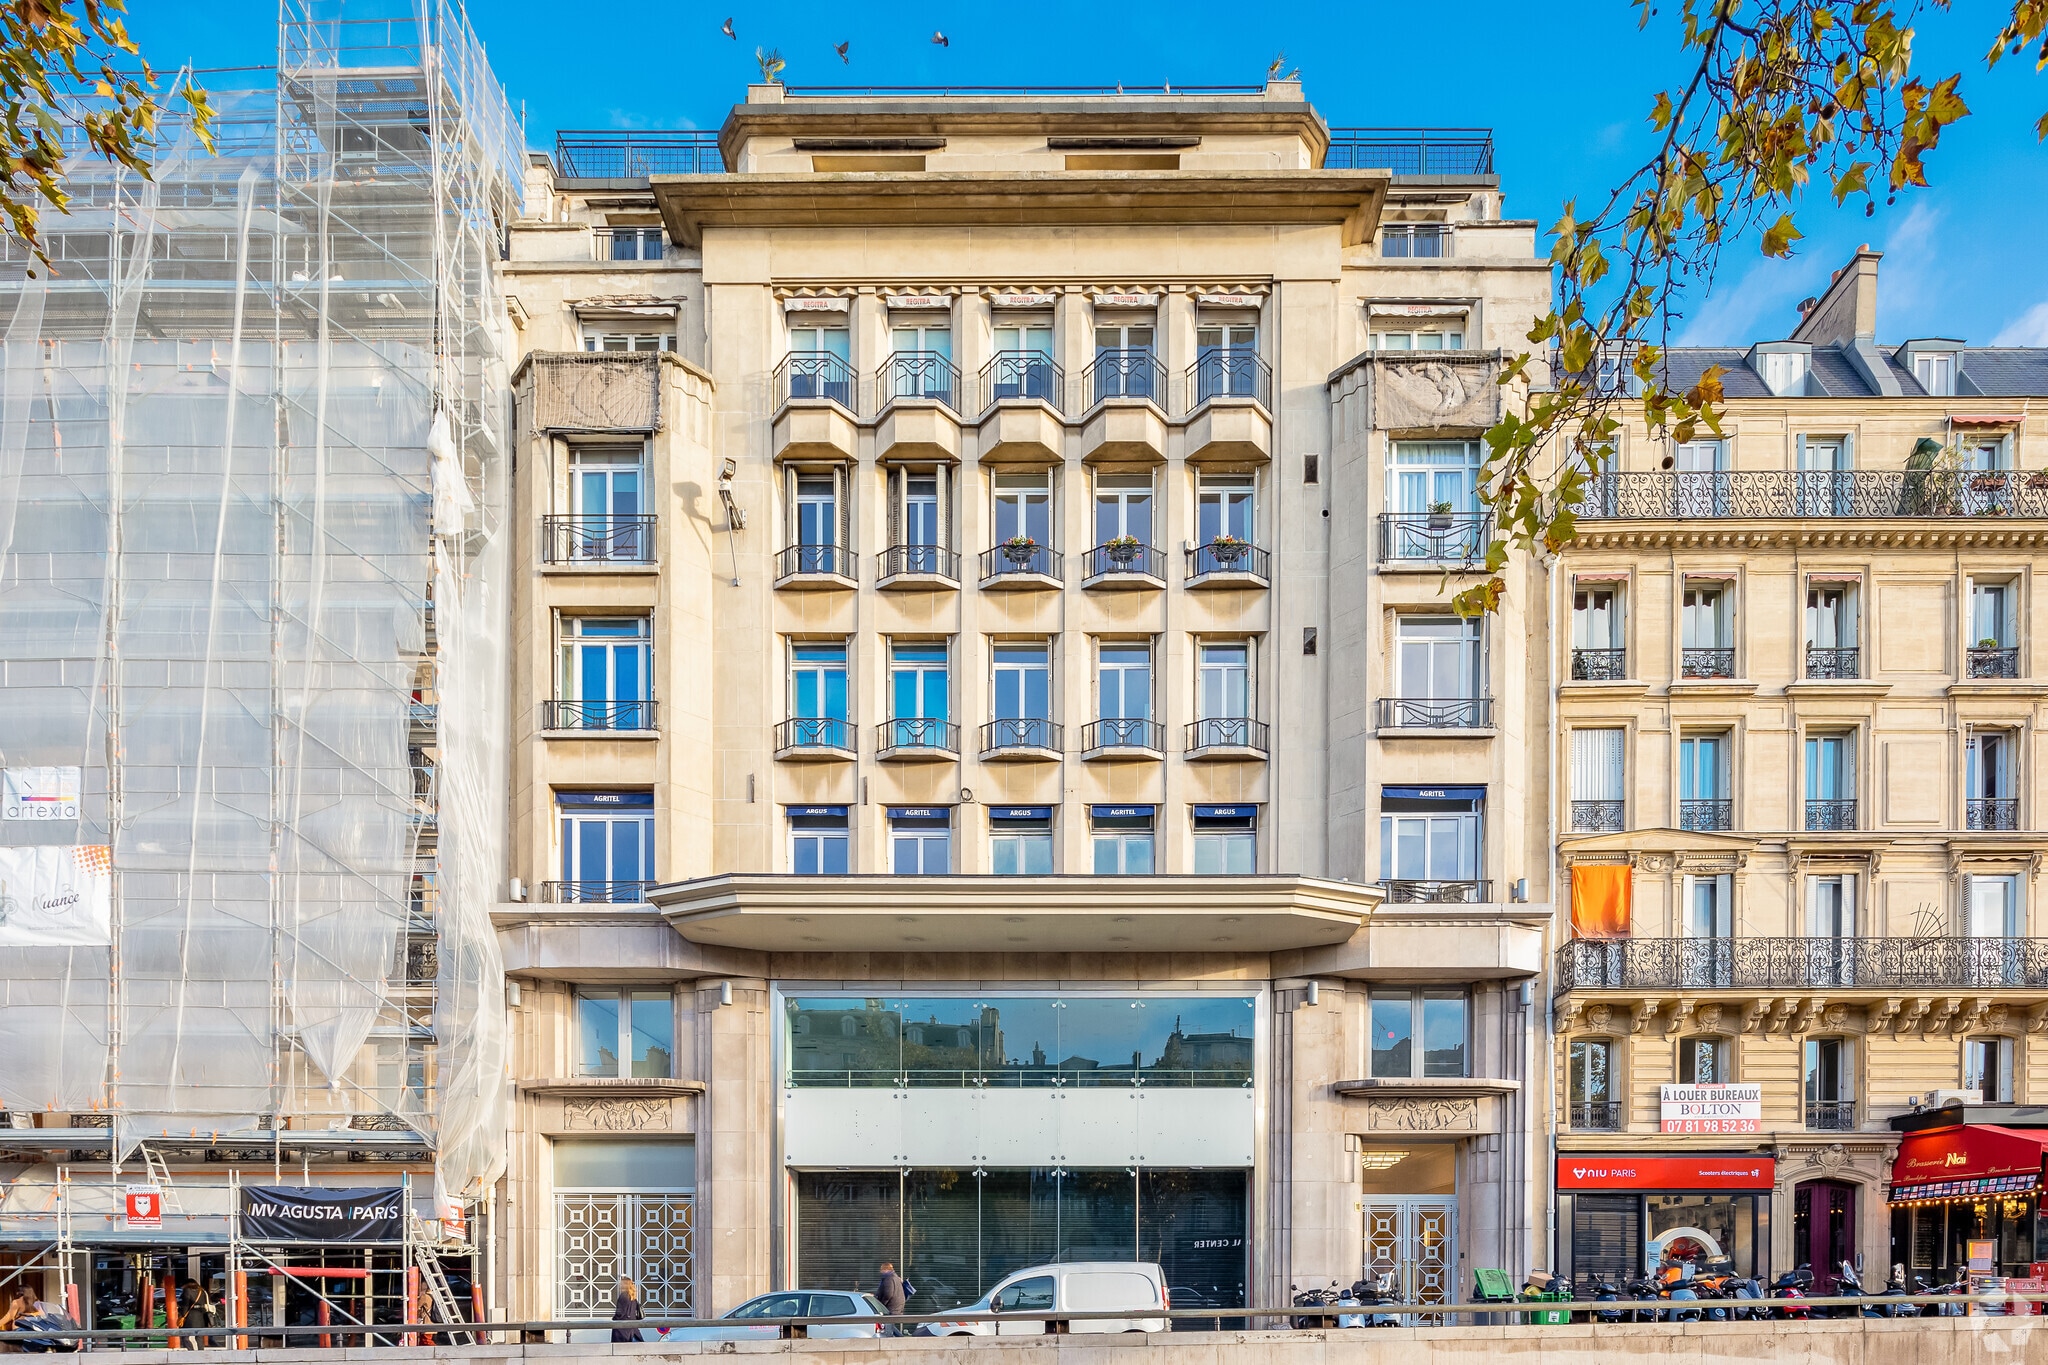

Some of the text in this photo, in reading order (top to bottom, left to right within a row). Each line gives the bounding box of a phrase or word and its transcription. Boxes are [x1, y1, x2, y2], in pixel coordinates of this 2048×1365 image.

[7, 802, 76, 818] artexia
[32, 893, 80, 915] Nuance
[1663, 1087, 1759, 1101] À LOUER BUREAUX
[1681, 1104, 1742, 1115] BOLTON
[1667, 1120, 1755, 1132] 07 81 98 52 36
[1611, 1168, 1636, 1178] PARIS
[1720, 1169, 1749, 1177] électriques
[251, 1203, 399, 1220] MV AGUSTA PARIS
